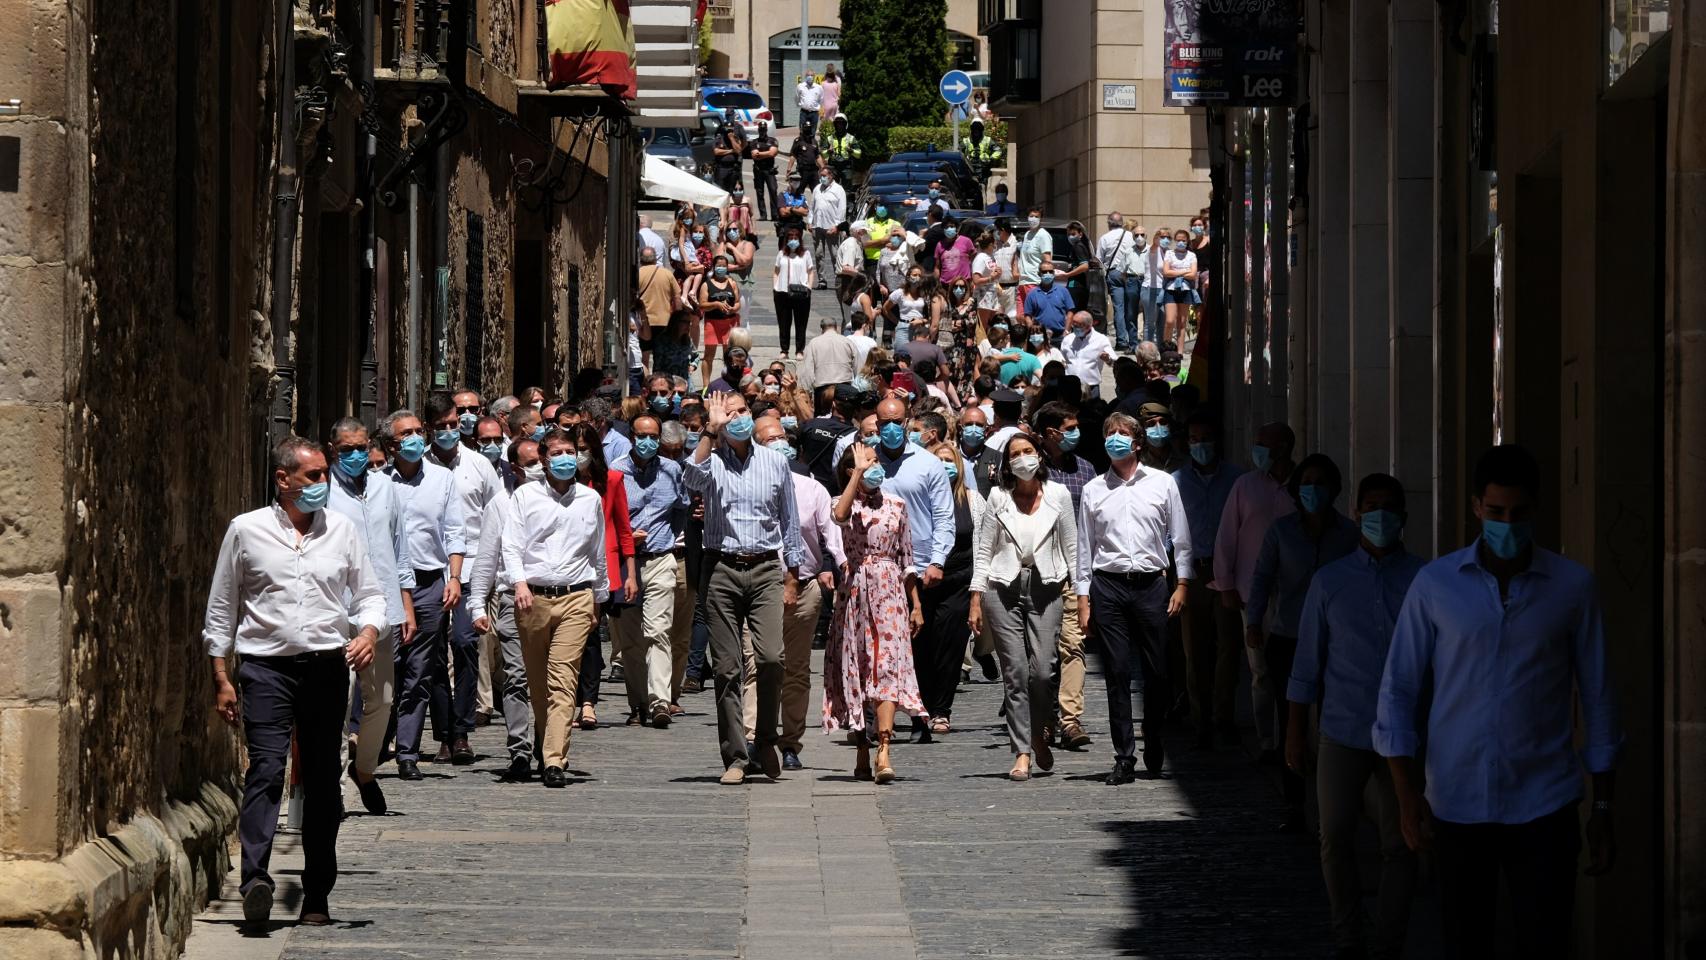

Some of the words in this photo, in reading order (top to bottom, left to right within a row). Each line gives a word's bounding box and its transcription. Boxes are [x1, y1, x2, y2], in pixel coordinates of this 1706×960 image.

[1179, 47, 1201, 58] BLUE
[1201, 47, 1224, 58] KING
[1243, 46, 1284, 61] rok
[1178, 76, 1224, 89] Wrangler
[1242, 75, 1283, 98] Lee
